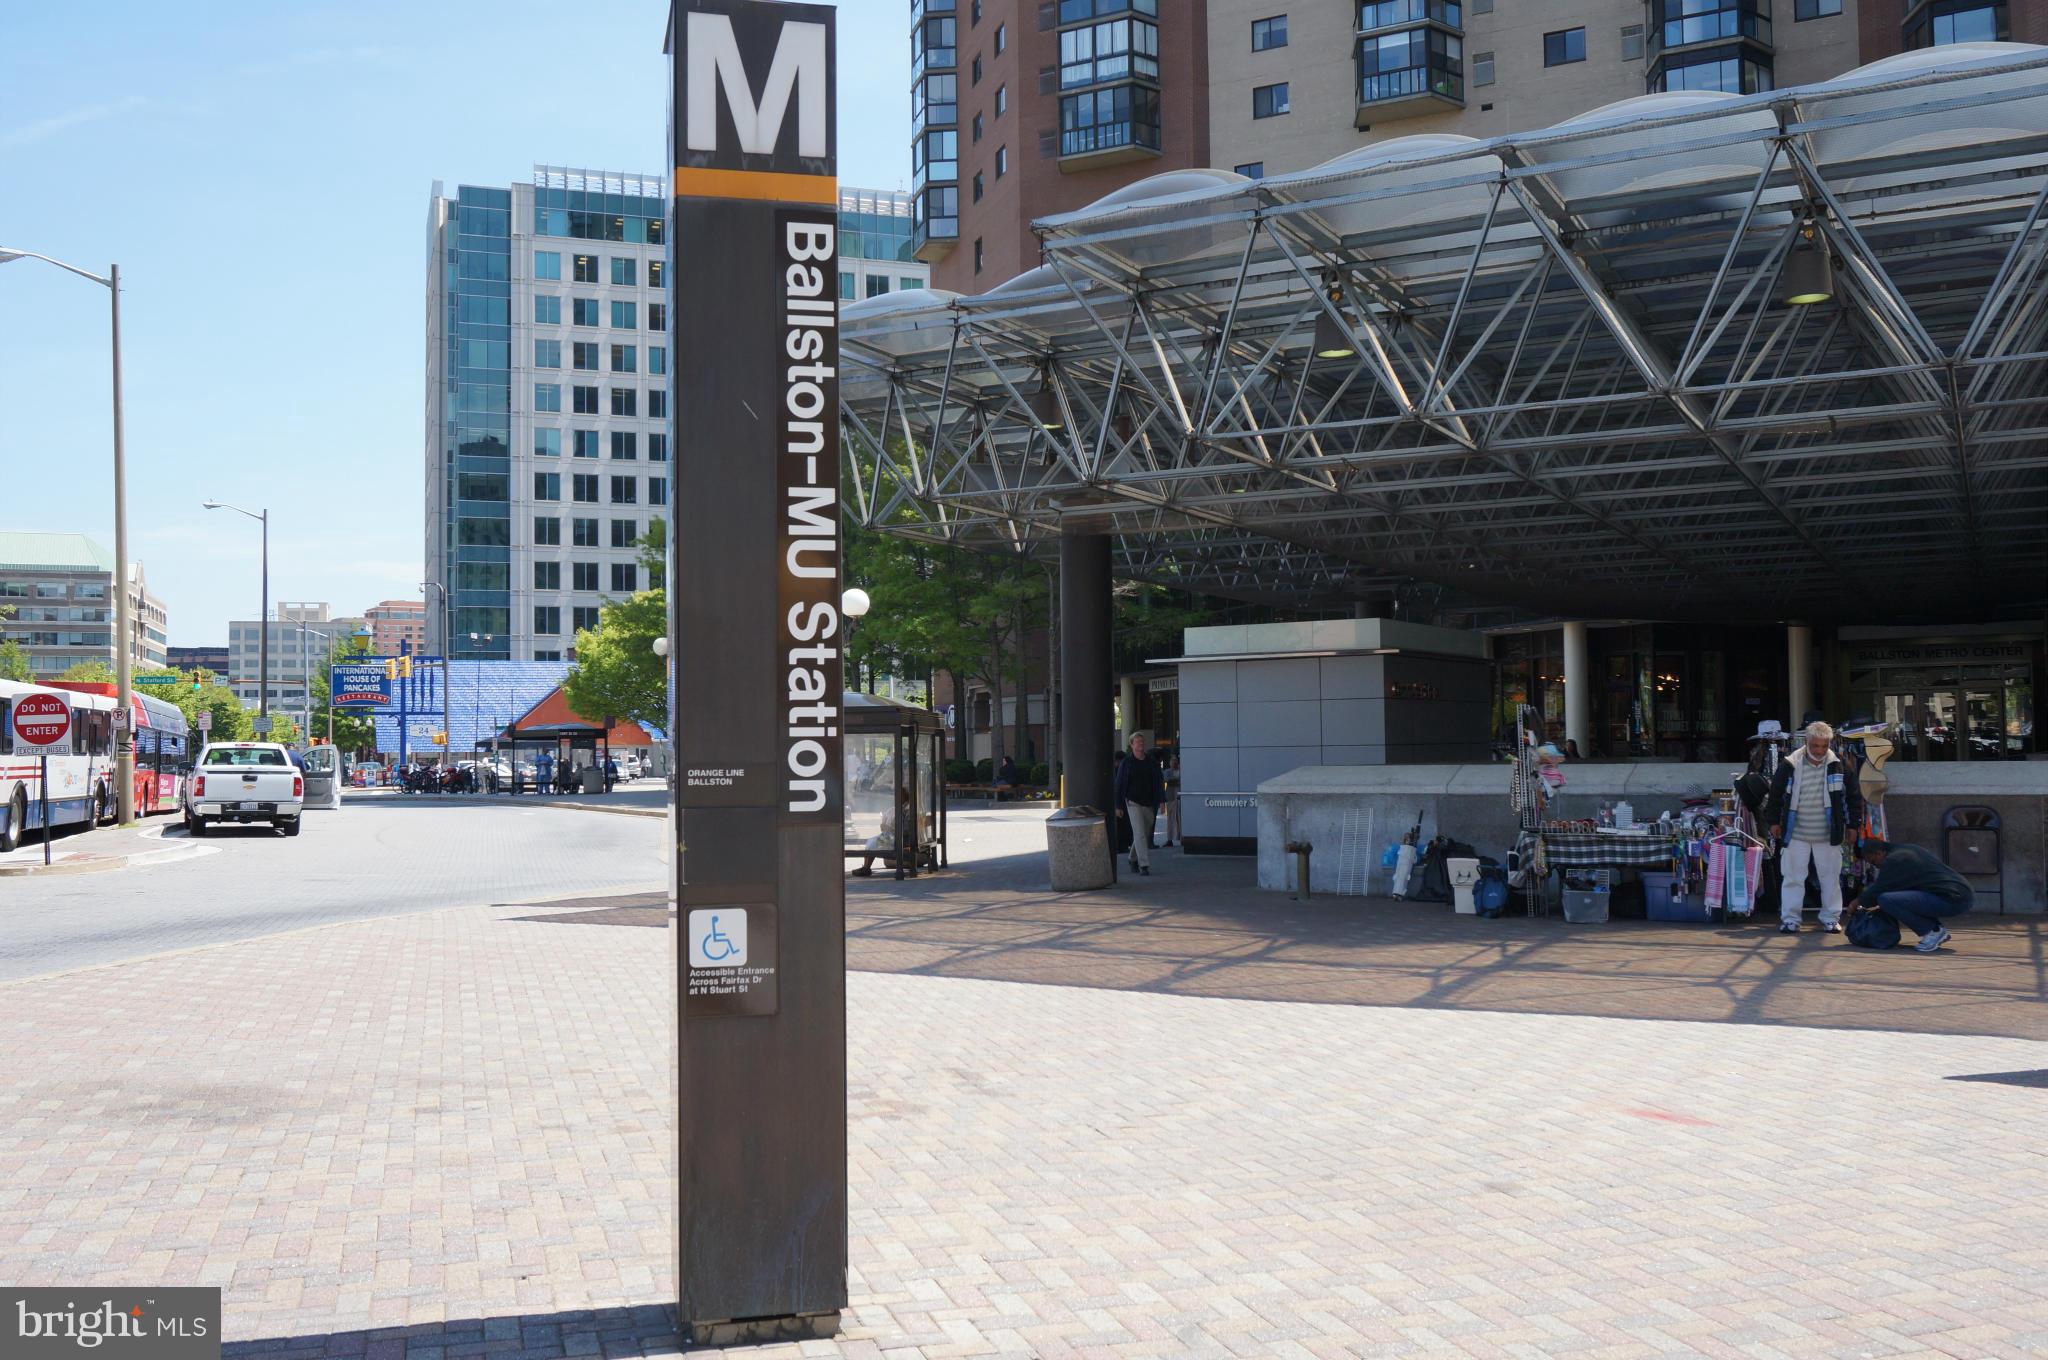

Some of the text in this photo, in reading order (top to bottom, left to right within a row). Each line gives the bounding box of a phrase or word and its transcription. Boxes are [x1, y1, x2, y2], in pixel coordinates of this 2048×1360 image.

[687, 11, 826, 158] M
[1858, 646, 2024, 661] BALLSTON METRO CENTER
[334, 667, 389, 675] INTERNATIONA
[343, 675, 381, 683] HOUSE OF
[343, 684, 381, 692] PANCAKES
[336, 694, 388, 702] RESTAURANT
[21, 703, 62, 713] DO NOT
[787, 601, 838, 812] Station
[26, 726, 59, 736] ENTER
[687, 768, 745, 777] ORANGE LINE
[687, 778, 733, 786] BALLSTON
[1204, 797, 1248, 807] Commuter
[689, 967, 775, 977] Accessible Entrance
[689, 976, 763, 986] Across Fairfax Dr
[689, 984, 748, 995] at N Stuart St
